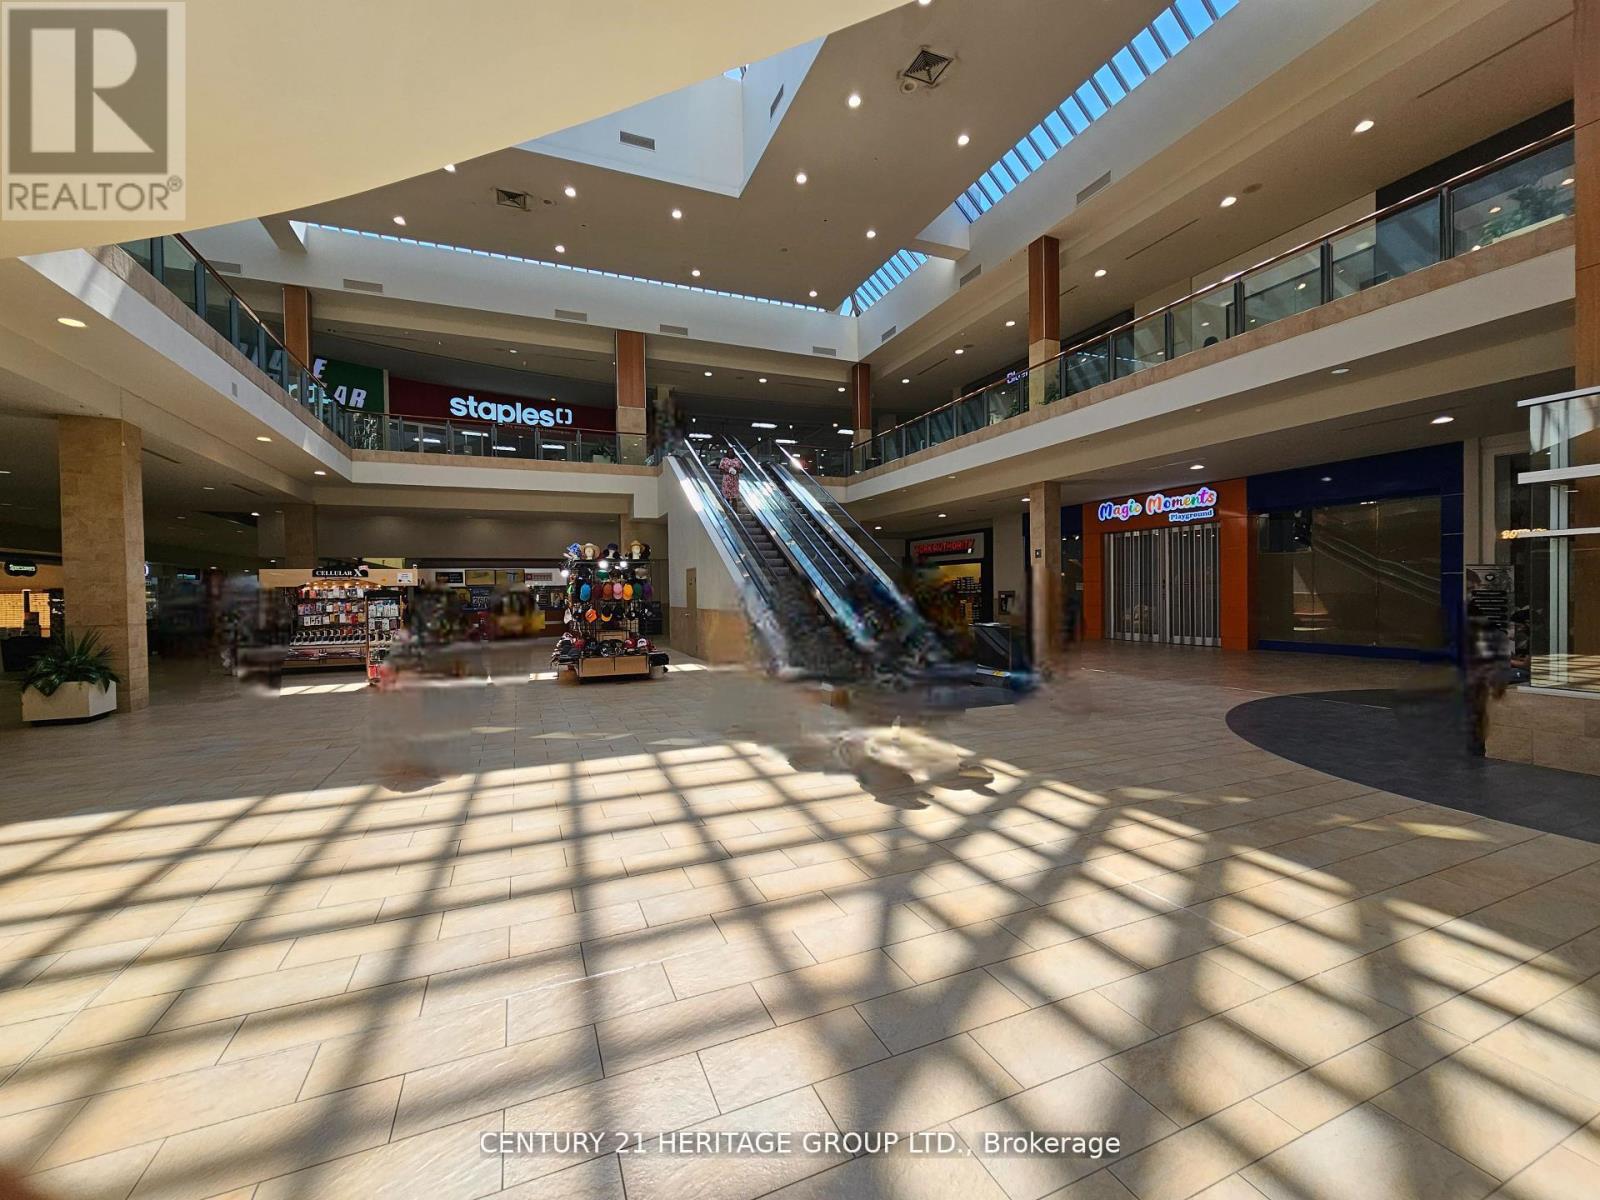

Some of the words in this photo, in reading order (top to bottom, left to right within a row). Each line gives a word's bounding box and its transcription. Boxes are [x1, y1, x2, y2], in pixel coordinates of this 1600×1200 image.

[449, 395, 556, 427] staples
[1098, 498, 1143, 521] Magic
[1145, 487, 1218, 515] Moments
[1168, 508, 1215, 522] Playground
[354, 568, 363, 577] X
